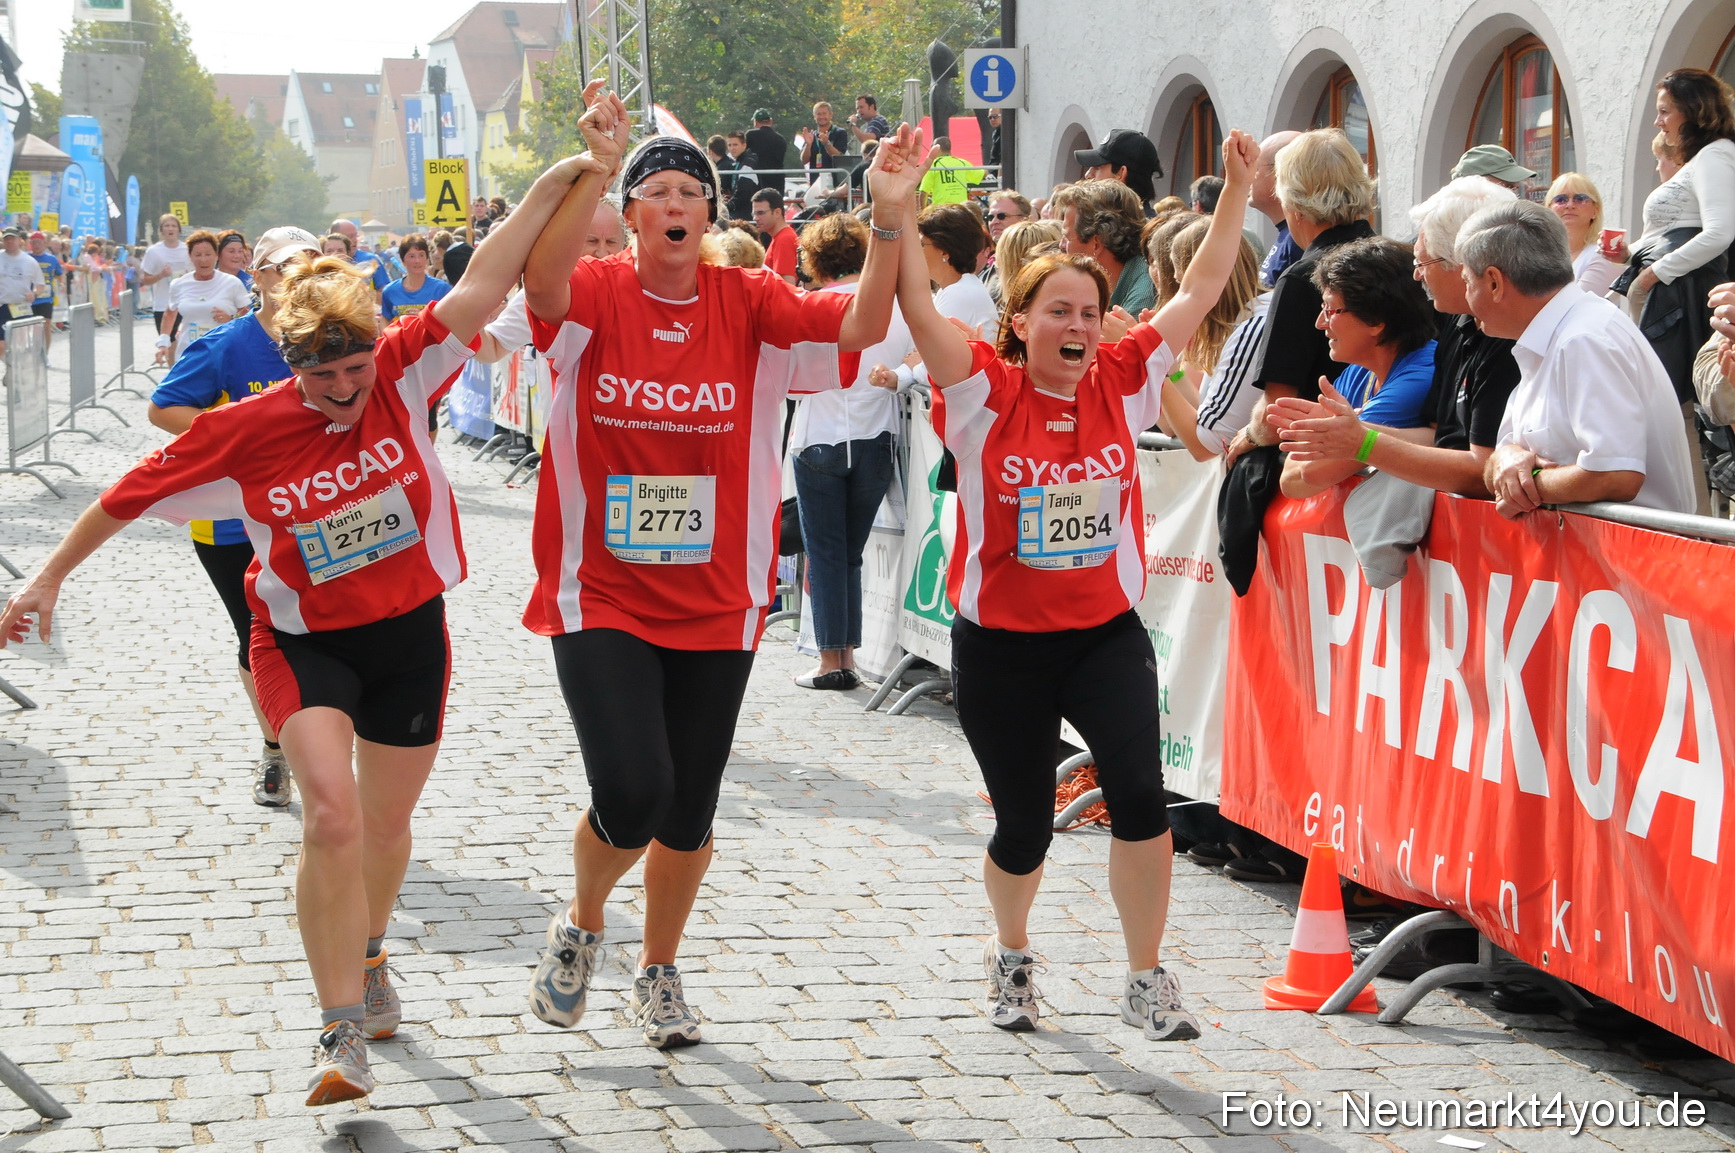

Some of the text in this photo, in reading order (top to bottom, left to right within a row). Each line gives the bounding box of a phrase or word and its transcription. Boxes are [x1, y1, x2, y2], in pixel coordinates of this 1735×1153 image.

[429, 162, 464, 174] Block
[436, 180, 461, 211] A
[417, 209, 425, 221] B
[653, 328, 685, 343] PUMA
[595, 373, 736, 412] SYSCAD
[593, 413, 735, 434] www.metallbau-cad.de
[1046, 421, 1074, 432] PUMA
[1001, 443, 1126, 487] SYSCAD
[267, 437, 405, 517] SYSCAD
[638, 483, 688, 503] Brigitte
[1048, 492, 1082, 510] Tanja
[326, 510, 363, 531] Karin
[613, 507, 620, 520] D
[638, 509, 703, 532] 2773
[334, 513, 401, 550] 2779
[1023, 520, 1030, 533] D
[1049, 512, 1112, 543] 2054
[306, 542, 316, 552] D
[1302, 532, 1725, 865] PARKCA
